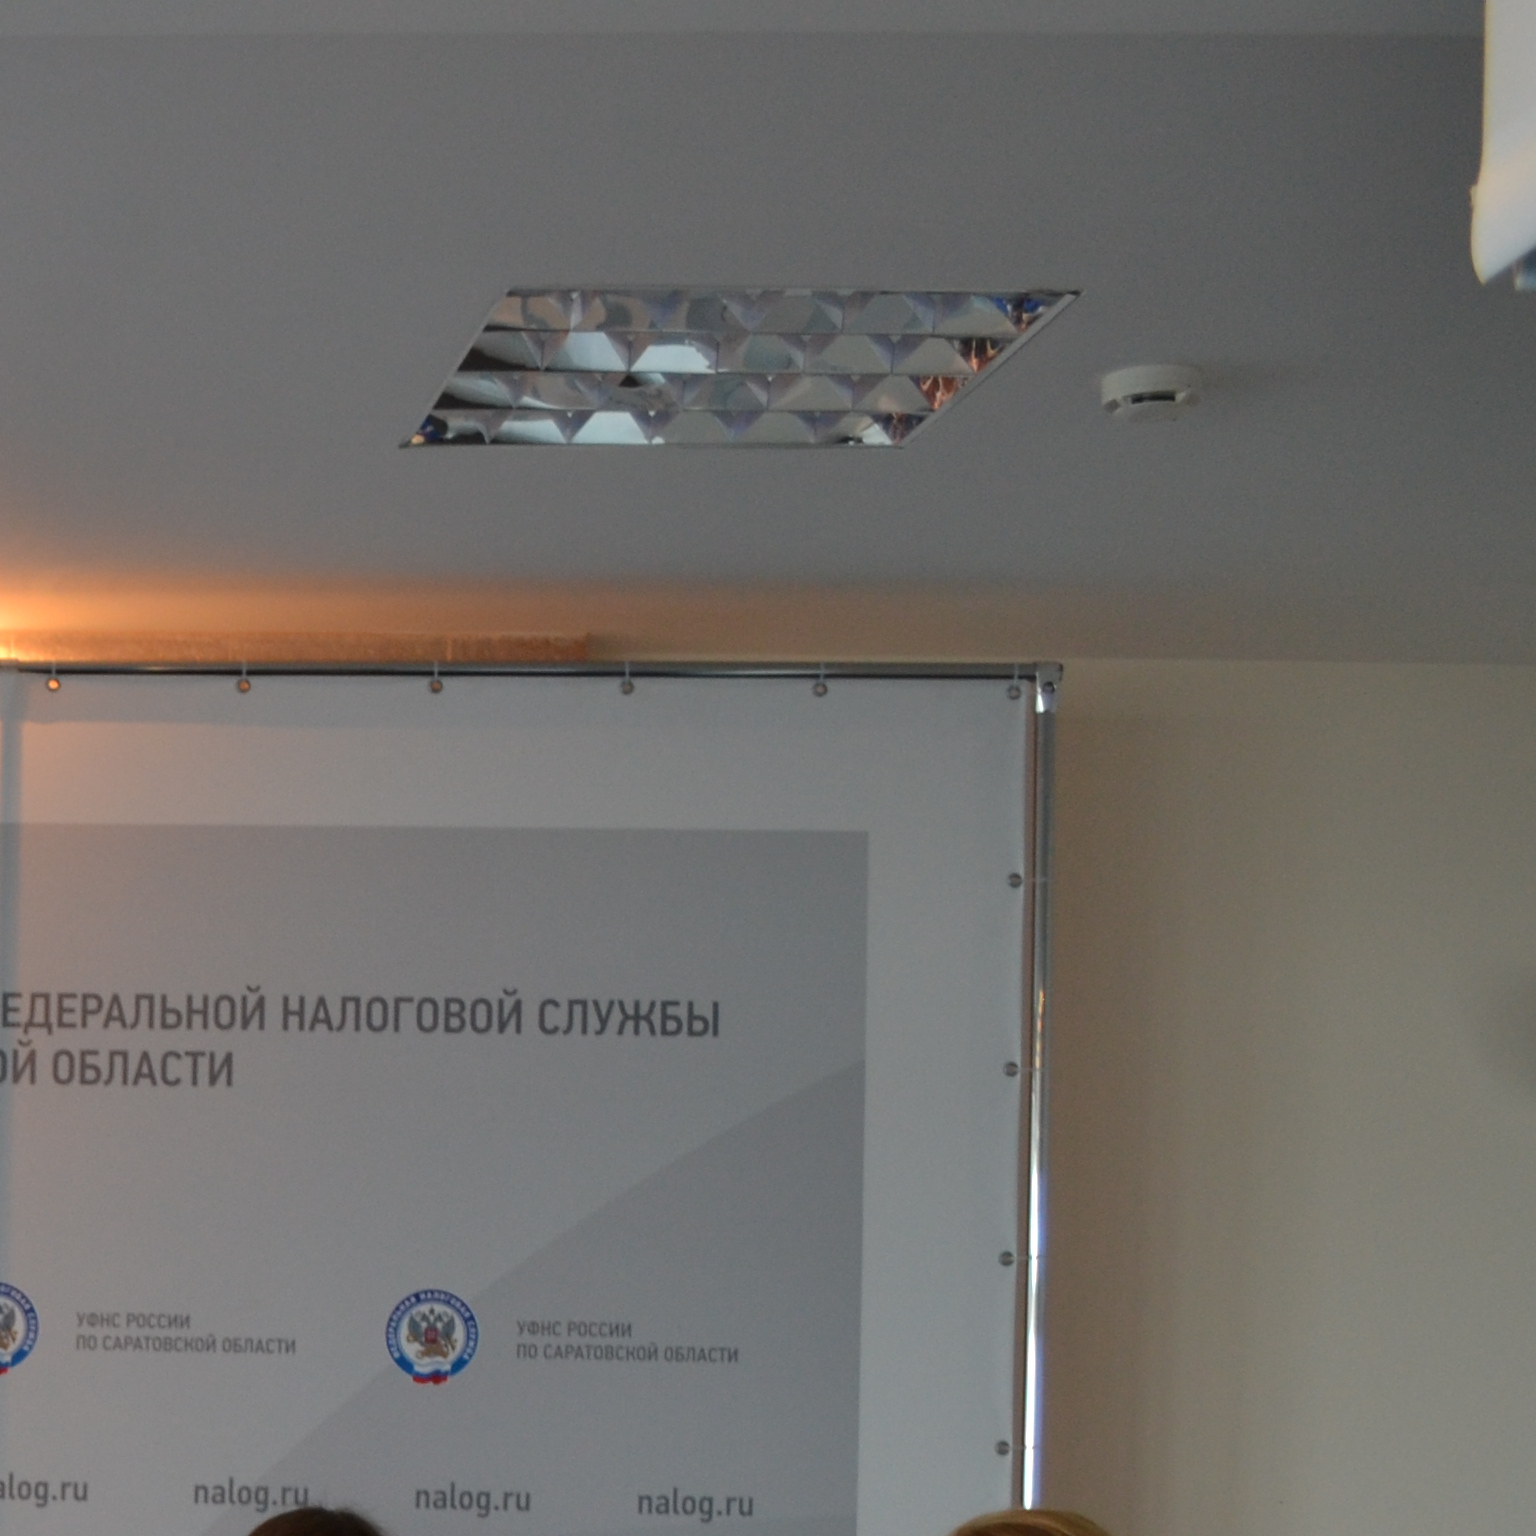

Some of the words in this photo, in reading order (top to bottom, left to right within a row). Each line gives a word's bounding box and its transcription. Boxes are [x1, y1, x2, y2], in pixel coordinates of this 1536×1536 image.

[282, 989, 522, 1034] НАЛОГОВОЙ
[538, 998, 719, 1037] СЛУЖБЫ
[52, 1049, 233, 1087] ОБЛАСТИ
[76, 1312, 120, 1328] УФНС
[126, 1313, 191, 1329] РОССИИ
[517, 1320, 561, 1337] УФНС
[567, 1321, 632, 1338] РОССИИ
[76, 1334, 98, 1351] ПО
[102, 1334, 217, 1353] САРАТОВСКОЙ
[222, 1337, 296, 1354] ОБЛАСТИ
[516, 1343, 538, 1359] ПО
[543, 1342, 659, 1362] САРАТОВСКОЙ
[664, 1346, 739, 1363] ОБЛАСТИ
[195, 1479, 312, 1517] nalog.ru
[415, 1482, 531, 1518] nalog.ru
[638, 1487, 753, 1524] nalog.ru
